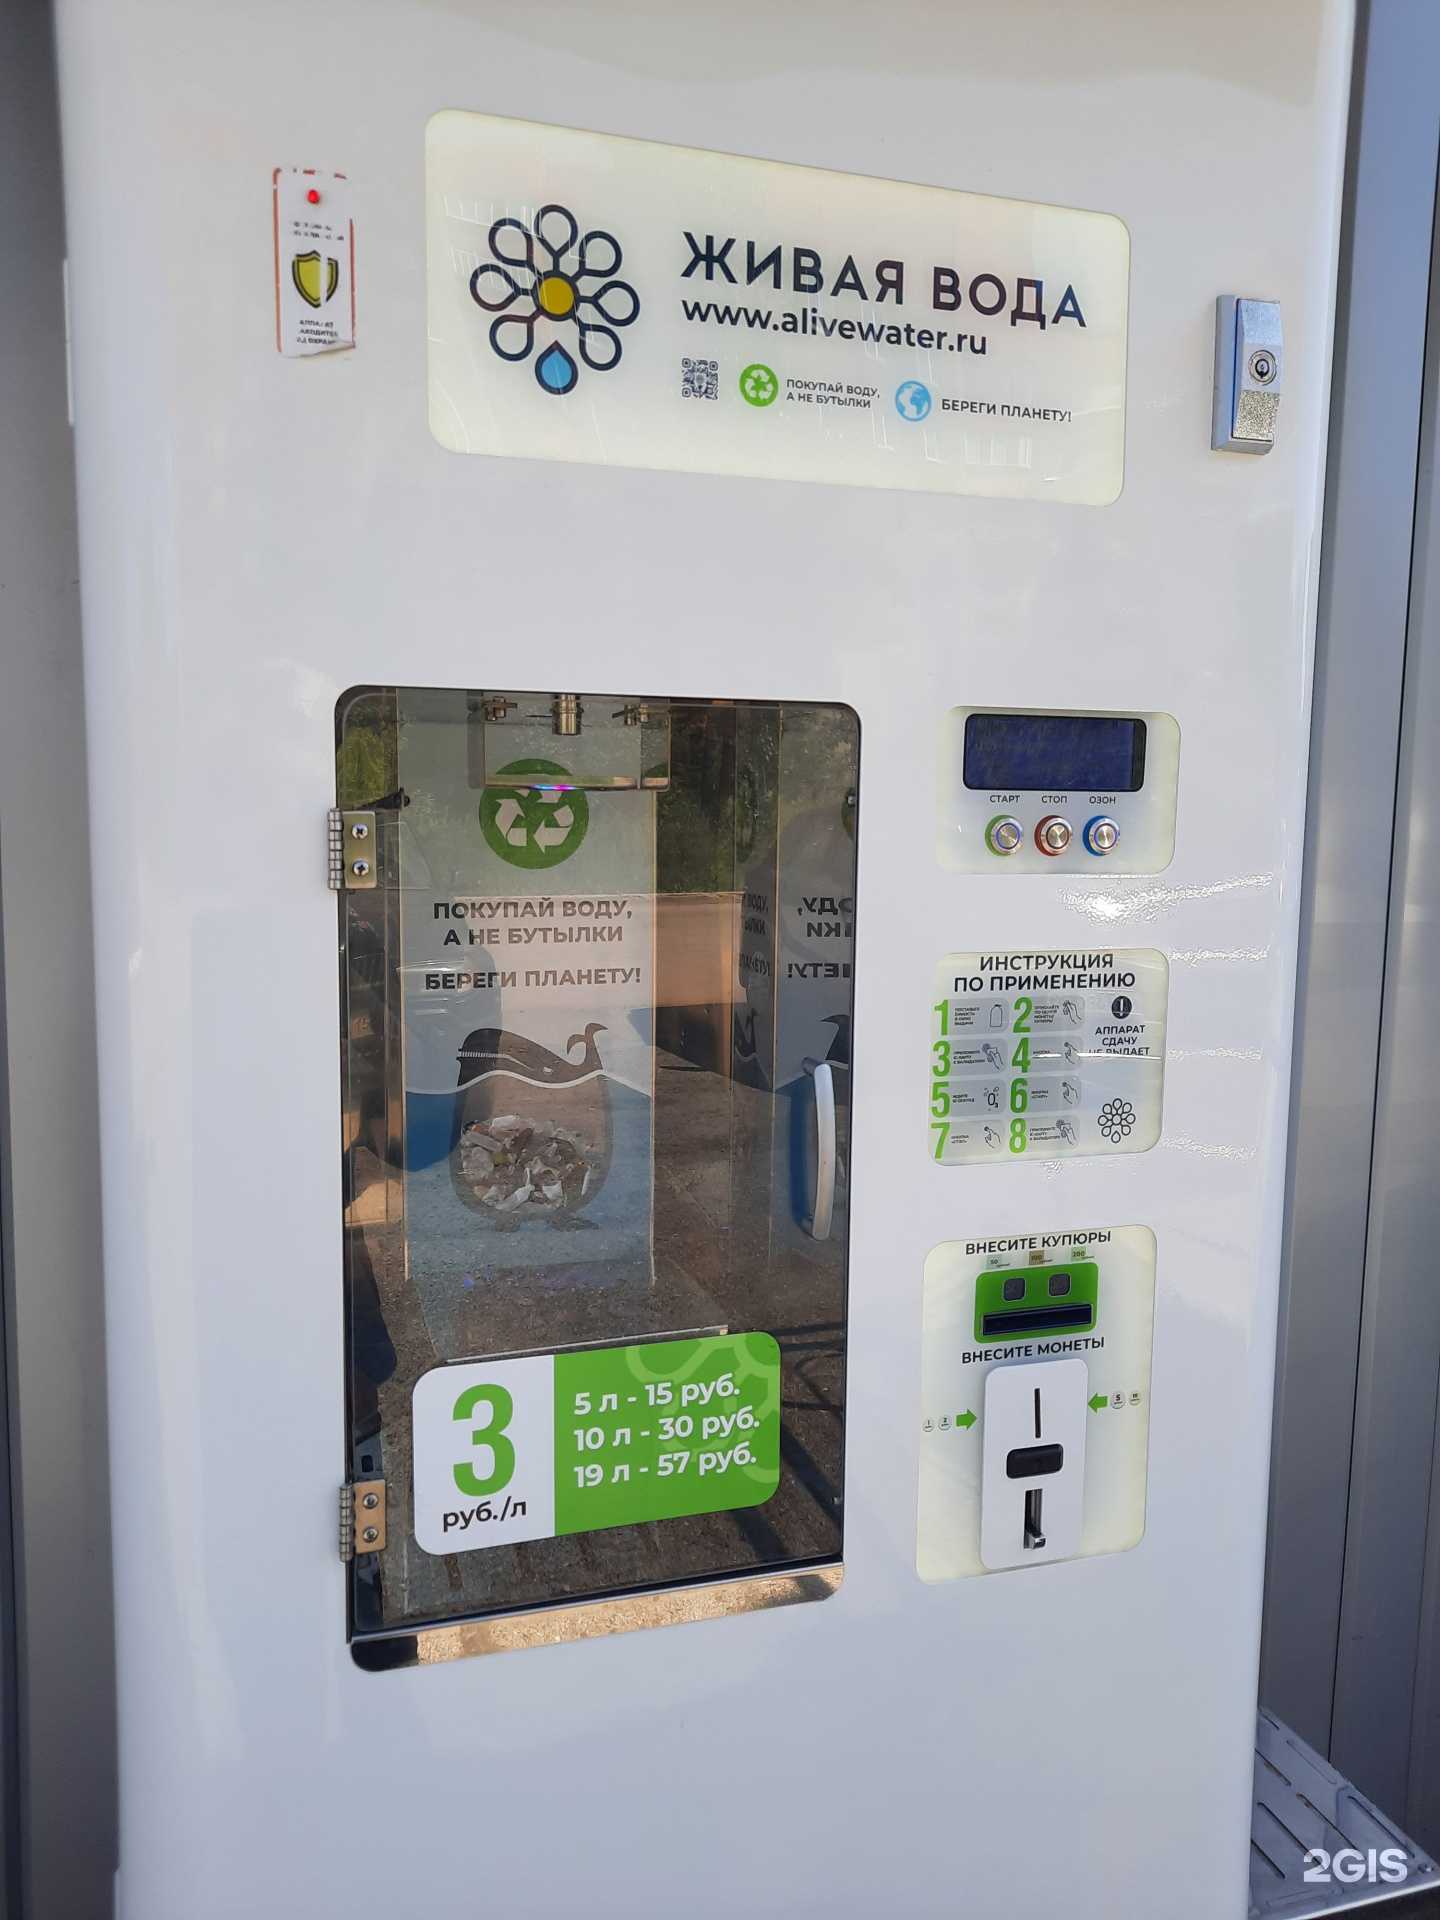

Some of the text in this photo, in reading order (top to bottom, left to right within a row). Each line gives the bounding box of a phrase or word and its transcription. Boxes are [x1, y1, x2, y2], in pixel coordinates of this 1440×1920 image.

[680, 231, 1088, 331] ЖИВАЯ ВОДА
[681, 299, 988, 355] www.alivewater.ru
[786, 378, 881, 399] ПОКУПАЙ ВОДУ,
[786, 393, 872, 409] А НЕ БУТЫЛКИ
[941, 398, 1072, 423] БЕРЕГИ ПЛАНЕТУ!
[989, 794, 1021, 804] СТАРТ
[1041, 795, 1068, 804] СТОП
[1088, 795, 1117, 805] ОЗОН
[433, 896, 633, 920] ПОКУПАЙ ВОДУ,
[443, 925, 623, 946] А НЕ БУТЫЛКИ
[425, 967, 641, 990] БЕРЕГИ ПЛАНЕТУ!
[979, 953, 1114, 972] ИНСТРУКЦИЯ
[954, 972, 1136, 993] ПО ПРИМЕНЕНИЮ
[934, 999, 949, 1036] 1
[1012, 997, 1033, 1034] 2
[1095, 1024, 1146, 1036] АППАРАТ
[1011, 1037, 1032, 1074] 4
[1102, 1036, 1138, 1048] СДАЧУ
[932, 1040, 951, 1077] 3
[931, 1081, 951, 1118] 5
[1010, 1077, 1029, 1114] 6
[930, 1121, 951, 1160] 7
[1009, 1117, 1028, 1154] 8
[965, 1230, 1112, 1255] ВНЕСИТЕ КУПЮРЫ
[961, 1336, 1105, 1364] ВНЕСИТЕ МОНЕТЫ
[573, 1392, 592, 1416] 5
[599, 1391, 618, 1413] л
[645, 1381, 673, 1407] 15
[681, 1372, 740, 1407] руб.
[452, 1383, 517, 1498] 3
[573, 1426, 605, 1452] 10
[612, 1427, 631, 1448] л
[658, 1415, 694, 1441] 30
[702, 1405, 760, 1438] руб.
[573, 1464, 604, 1488] 19
[611, 1463, 630, 1485] л
[657, 1450, 691, 1477] 57
[699, 1441, 757, 1476] руб.
[442, 1495, 527, 1533] руб./л
